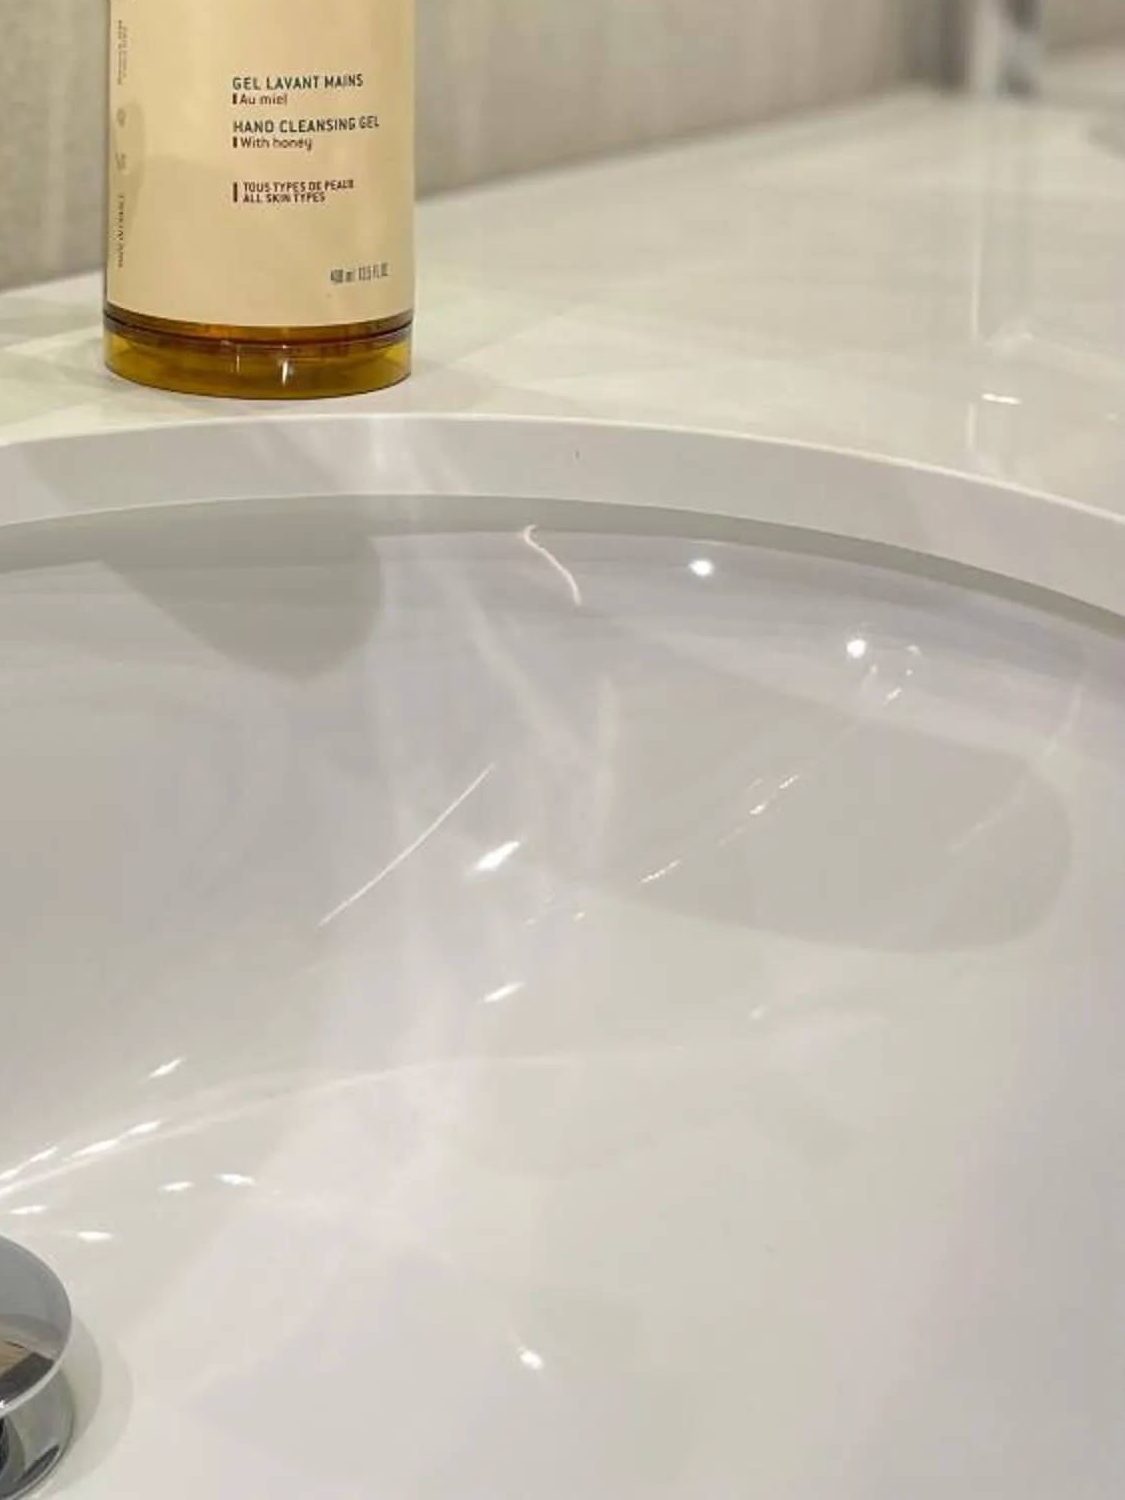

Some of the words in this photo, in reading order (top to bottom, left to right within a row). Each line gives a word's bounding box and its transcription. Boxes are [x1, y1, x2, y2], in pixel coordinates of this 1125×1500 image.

[232, 77, 261, 91] GEL
[266, 75, 319, 90] LAVANT
[324, 73, 364, 88] MAINS
[239, 93, 257, 106] Au
[259, 93, 288, 105] miel
[233, 119, 274, 133] HAND
[279, 116, 356, 132] CLEANSING
[359, 115, 380, 129] GEL
[240, 137, 270, 149] With
[272, 137, 313, 151] honey
[243, 181, 272, 193] TOUS
[274, 180, 307, 193] TYPES
[294, 192, 326, 203] TYPES
